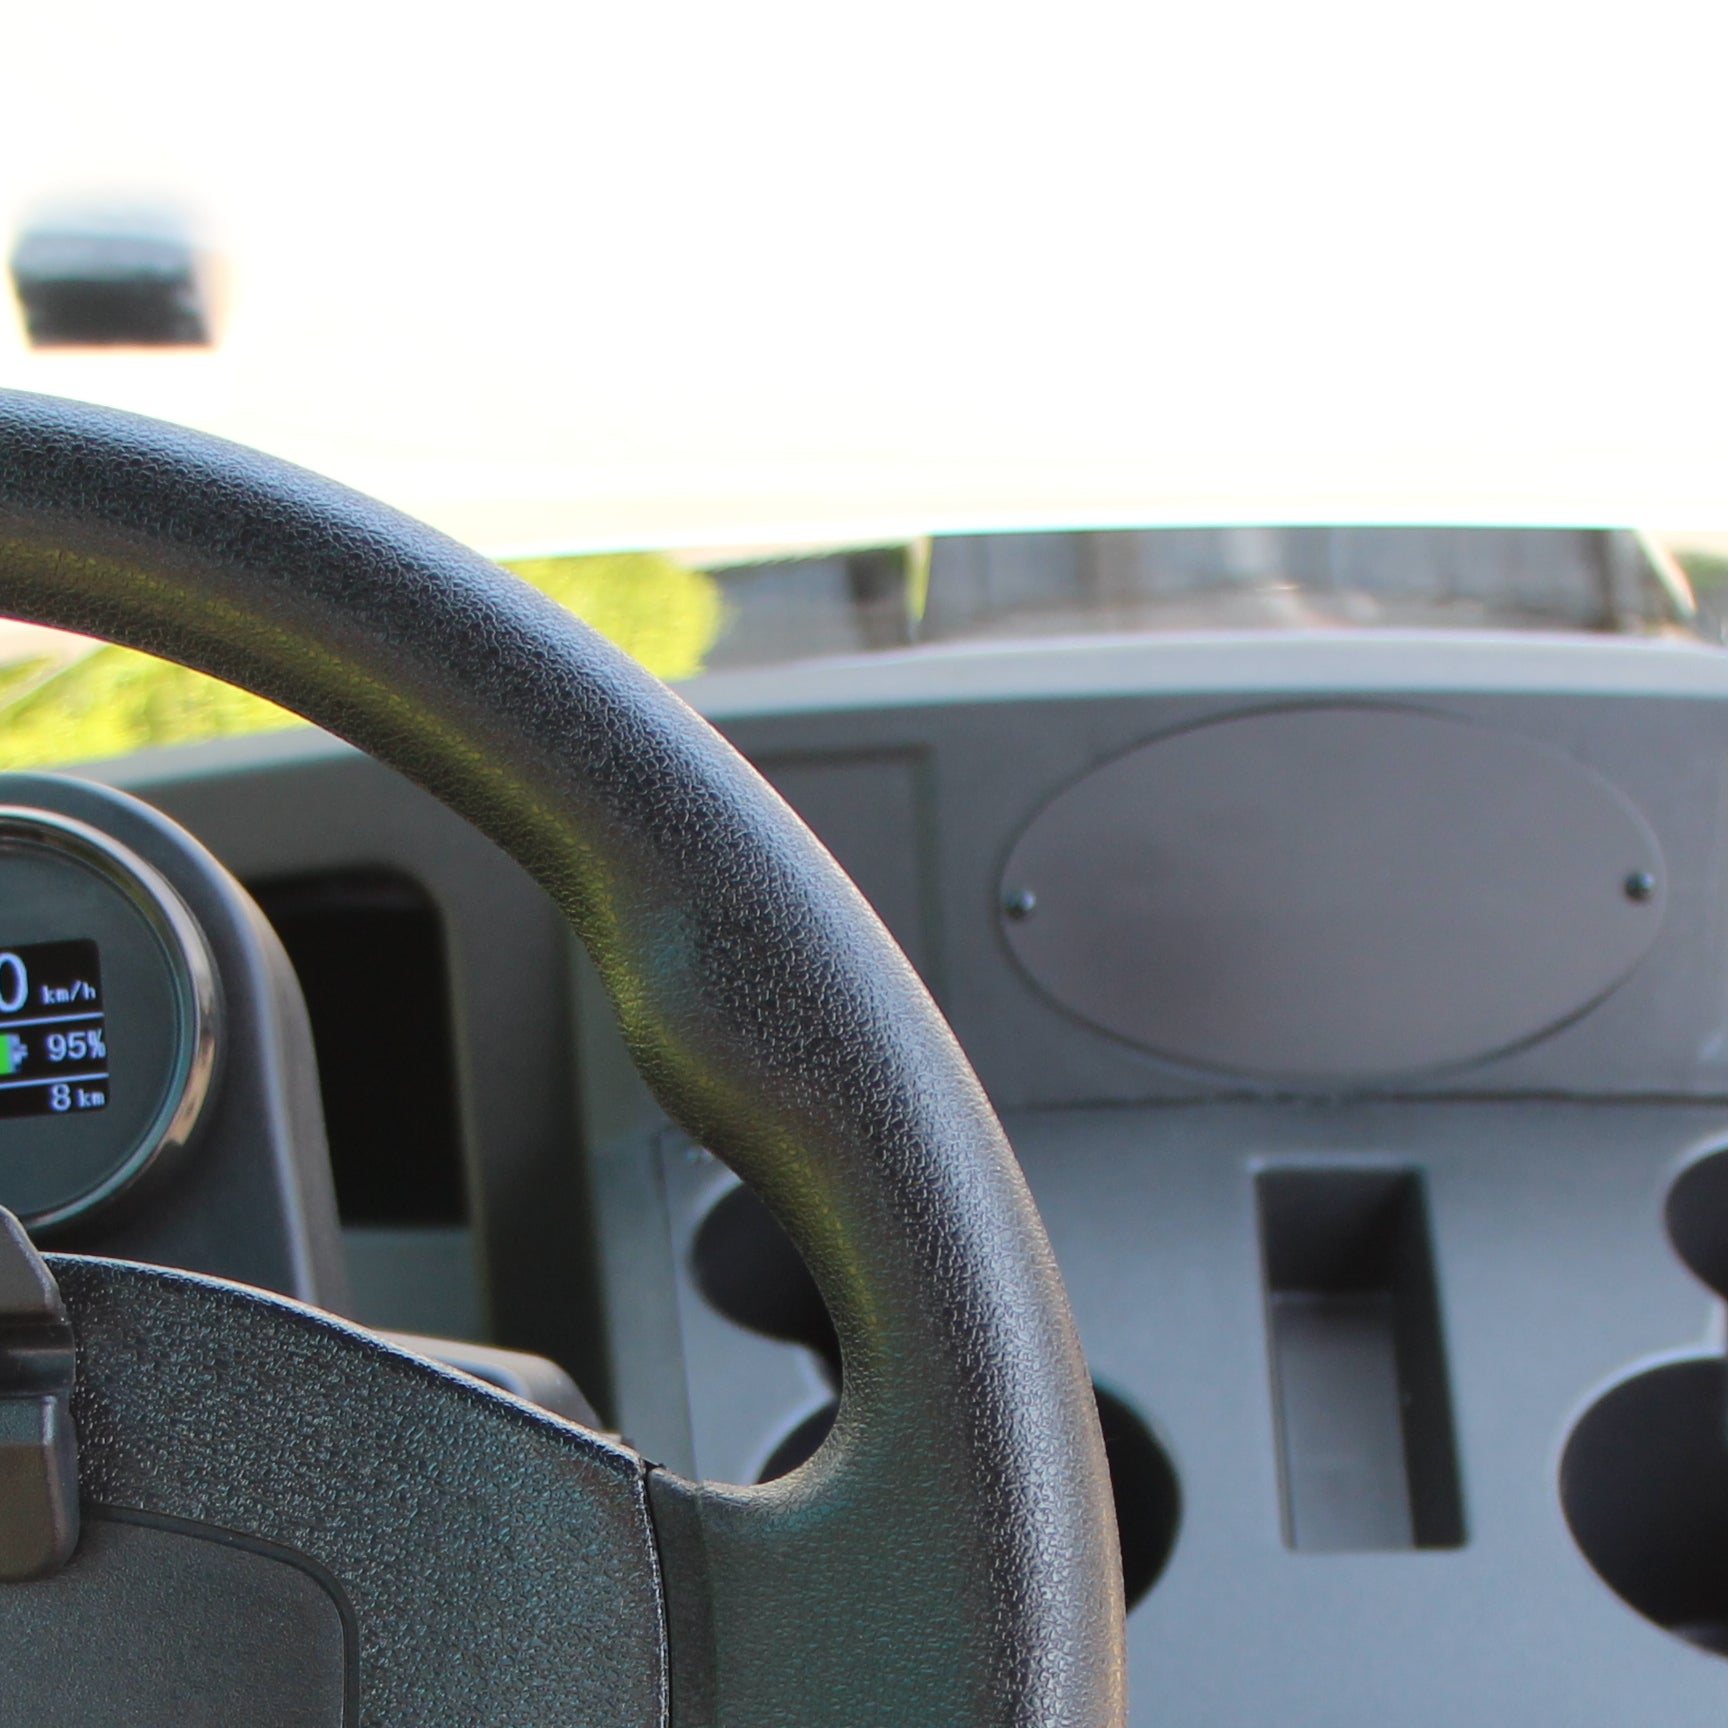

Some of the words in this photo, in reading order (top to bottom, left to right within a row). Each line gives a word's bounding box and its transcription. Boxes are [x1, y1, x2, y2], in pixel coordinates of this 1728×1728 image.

[41, 979, 97, 1004] km/h
[46, 1029, 106, 1062] 95%
[51, 1083, 72, 1111] 8
[78, 1088, 105, 1107] km
